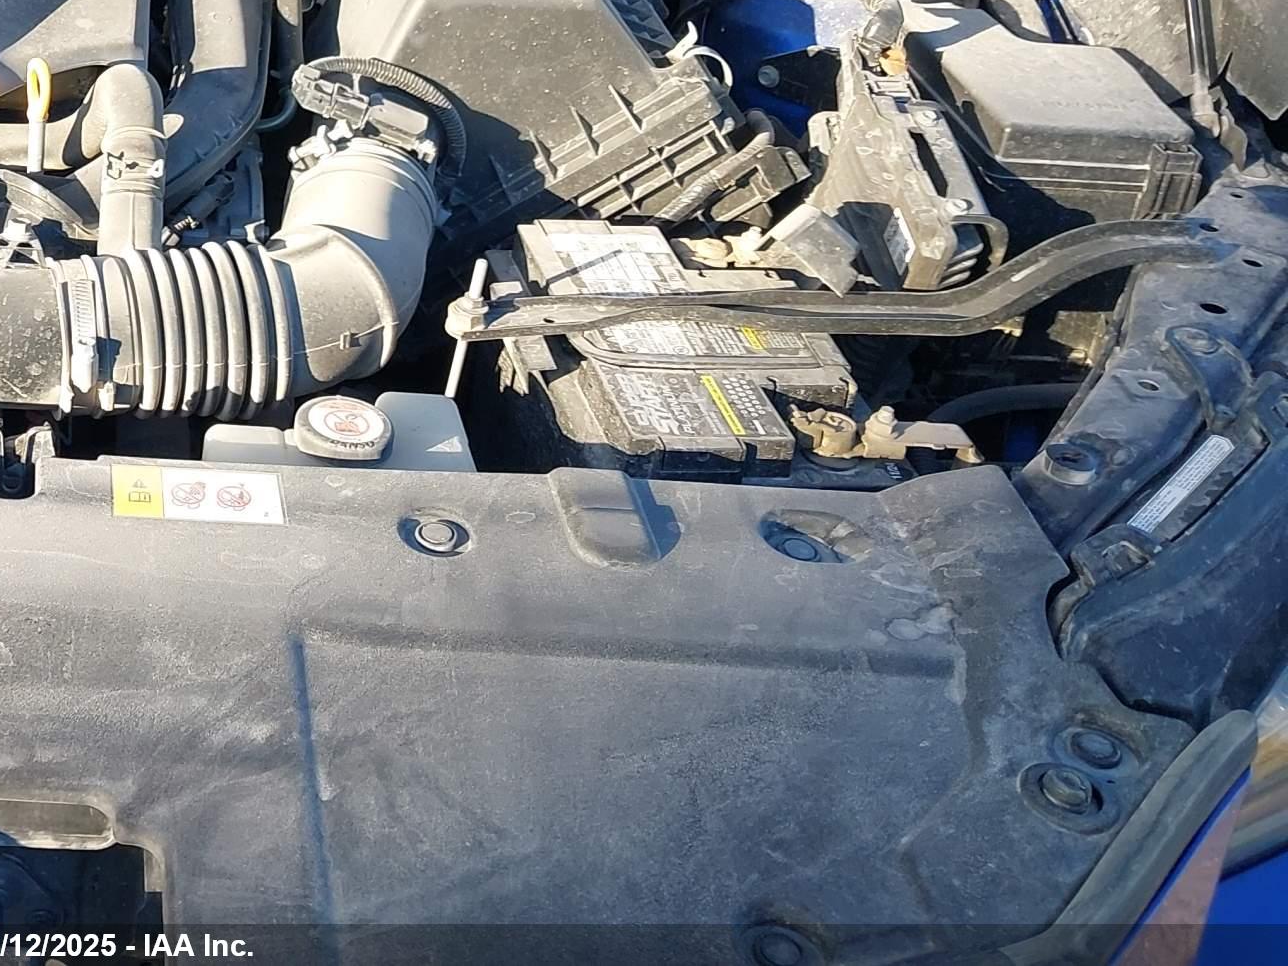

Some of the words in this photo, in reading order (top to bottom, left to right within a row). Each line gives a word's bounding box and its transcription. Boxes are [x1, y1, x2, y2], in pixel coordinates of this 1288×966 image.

[628, 373, 681, 436] START
[662, 384, 697, 436] PLATINUM
[330, 438, 377, 450] DENSO
